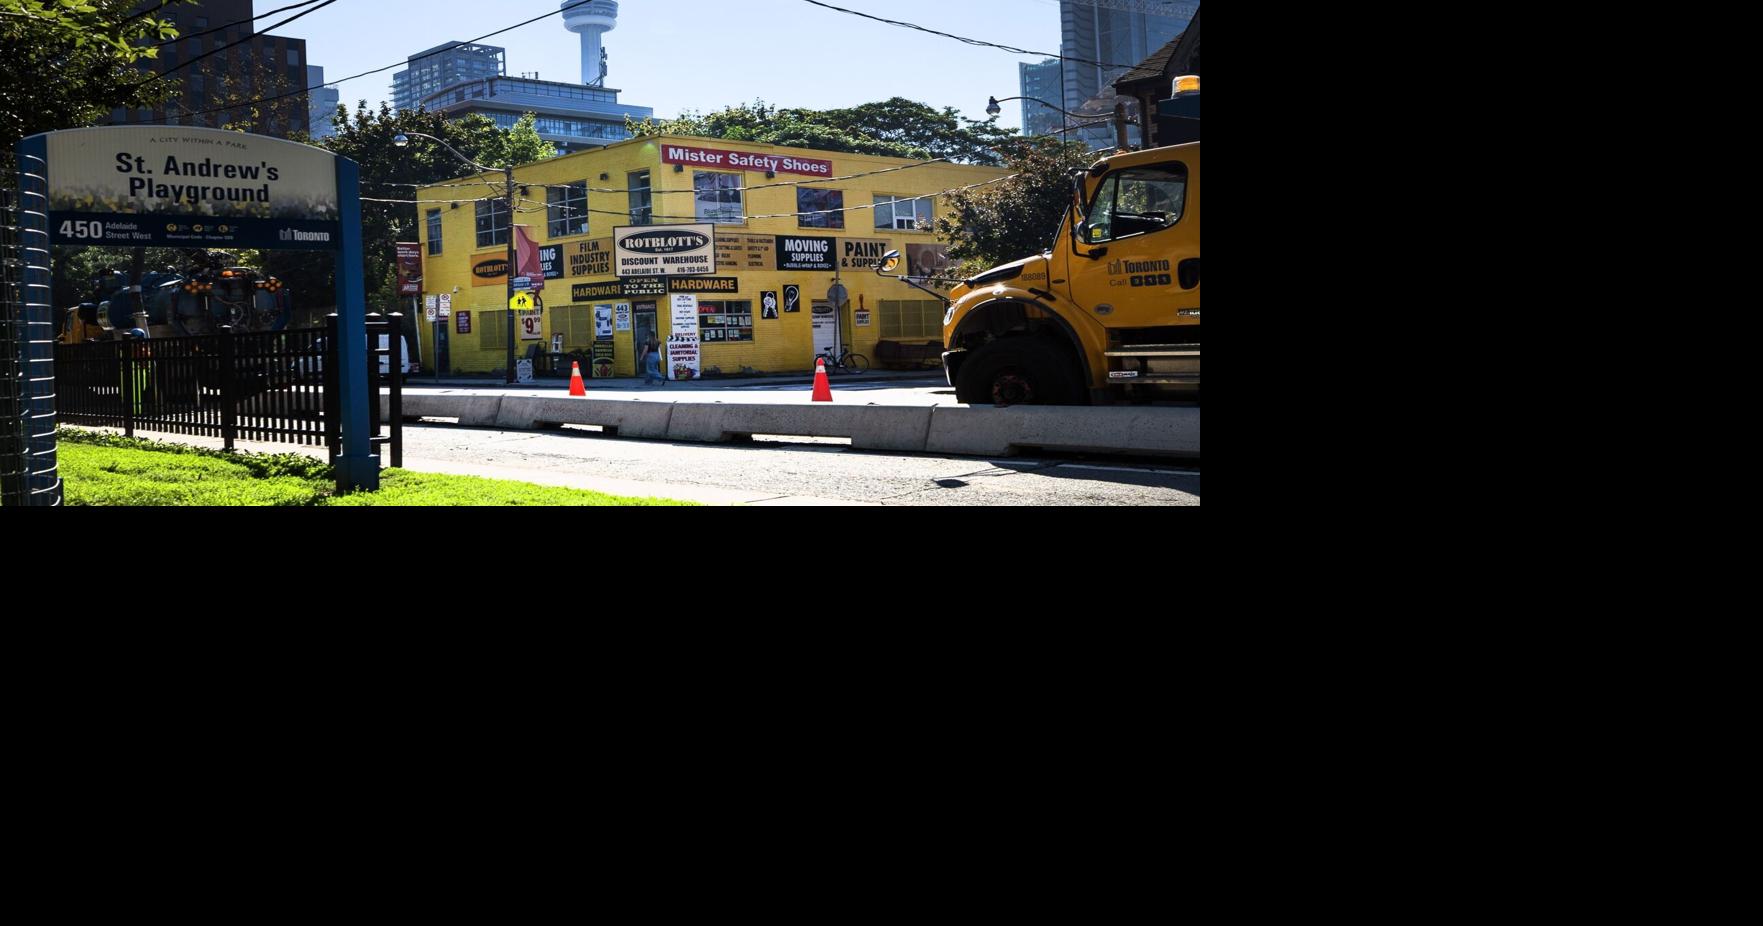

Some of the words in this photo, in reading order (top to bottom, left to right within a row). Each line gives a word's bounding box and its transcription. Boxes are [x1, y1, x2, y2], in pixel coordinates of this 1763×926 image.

[226, 142, 248, 150] PARK
[116, 152, 152, 174] St.
[164, 156, 279, 180] Andrew's
[668, 148, 723, 164] Mister
[728, 154, 778, 172] Safety
[782, 158, 828, 172] Shoes
[129, 177, 270, 204] Playground
[59, 220, 102, 238] 450
[106, 222, 138, 230] Adelaide
[106, 231, 131, 240] Street
[133, 232, 152, 240] West
[293, 230, 330, 242] TORONTO
[580, 241, 600, 252] FILM
[625, 236, 704, 248] ROTBLOTT'S
[784, 239, 828, 252] MOVING
[540, 248, 556, 262] ING
[845, 242, 886, 257] PAINT
[570, 251, 610, 265] INDUSTRY
[622, 257, 658, 266] DISCOUNT
[662, 256, 708, 264] WAREHOUSE
[792, 253, 824, 262] SUPPLIES
[842, 258, 848, 267] &
[476, 264, 508, 273] ROTBLOTT'
[540, 262, 552, 271] LIES
[572, 262, 609, 276] SUPPLIES
[1122, 260, 1170, 273] TORONTO
[671, 280, 735, 290] HARDWARE
